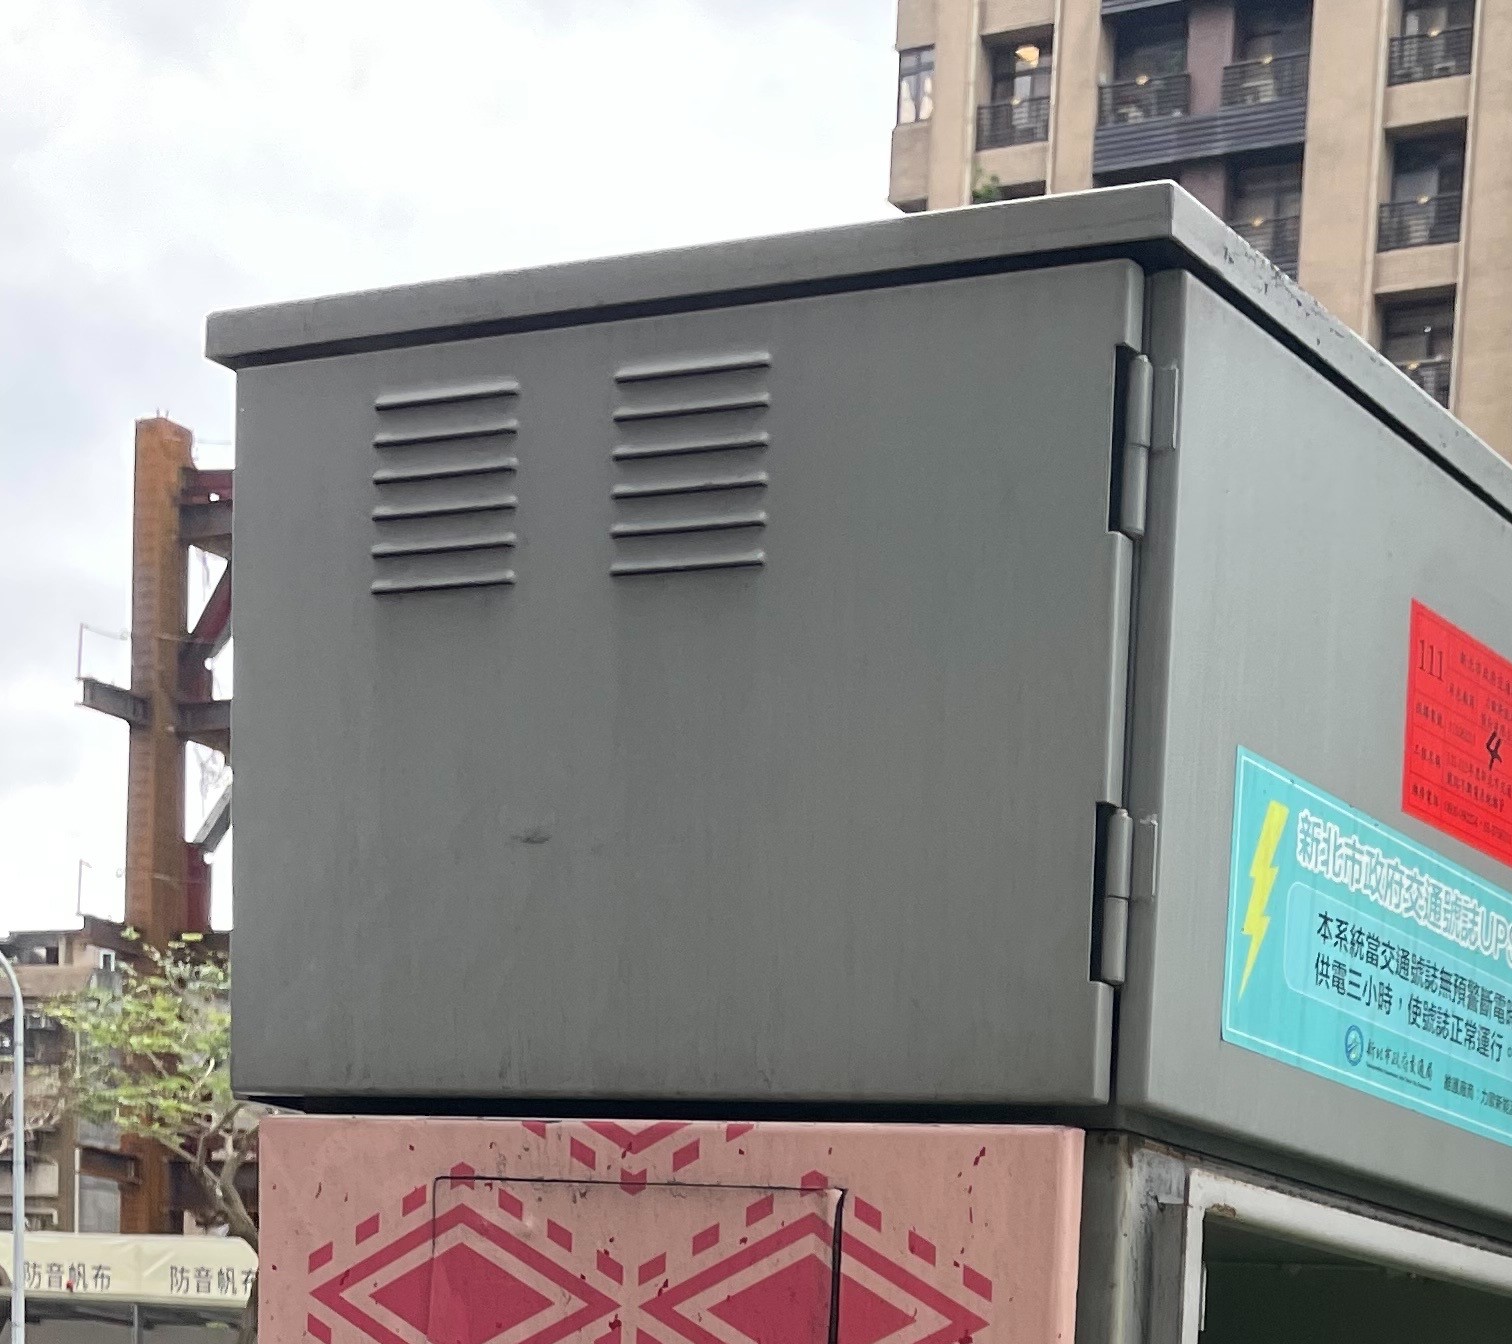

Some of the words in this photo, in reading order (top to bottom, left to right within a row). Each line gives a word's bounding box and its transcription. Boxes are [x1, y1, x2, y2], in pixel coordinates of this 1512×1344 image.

[24, 1261, 112, 1291] 防音帆布
[170, 1264, 257, 1295] 防音帆布
